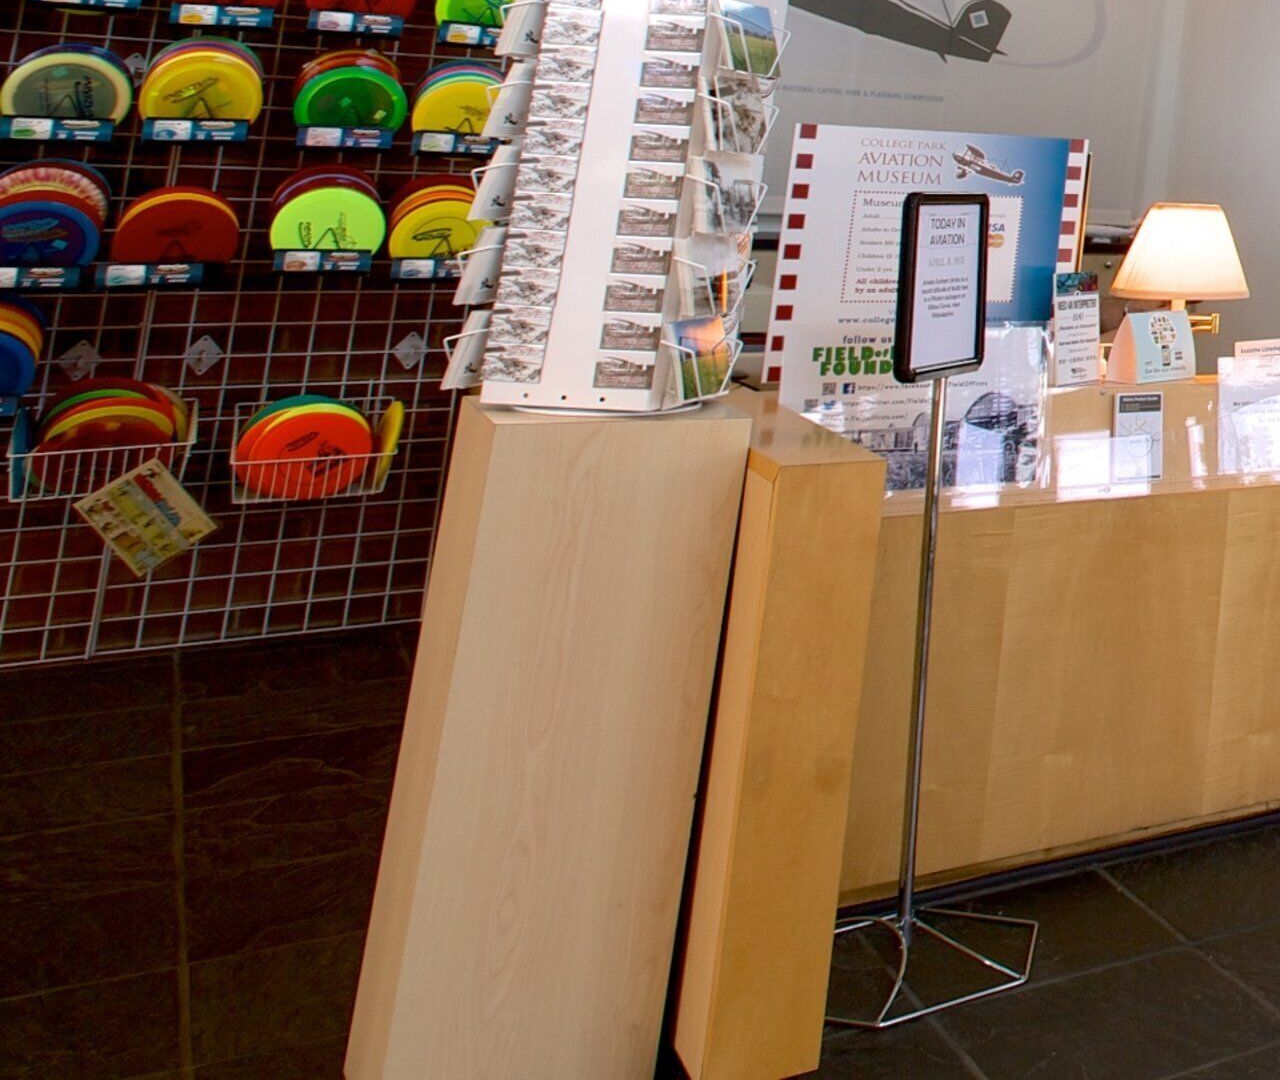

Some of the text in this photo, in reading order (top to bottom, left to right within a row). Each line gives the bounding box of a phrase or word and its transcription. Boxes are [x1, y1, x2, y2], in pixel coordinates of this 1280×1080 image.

[861, 138, 947, 151] COLLEGE PARK
[858, 151, 945, 168] AVIATION
[856, 170, 942, 186] MUSEUM
[862, 198, 904, 209] Museu
[930, 217, 956, 230] TODAY
[929, 233, 965, 246] AVIATION
[842, 334, 892, 345] follow us
[812, 345, 875, 362] FIELD
[819, 360, 894, 377] FOUND
